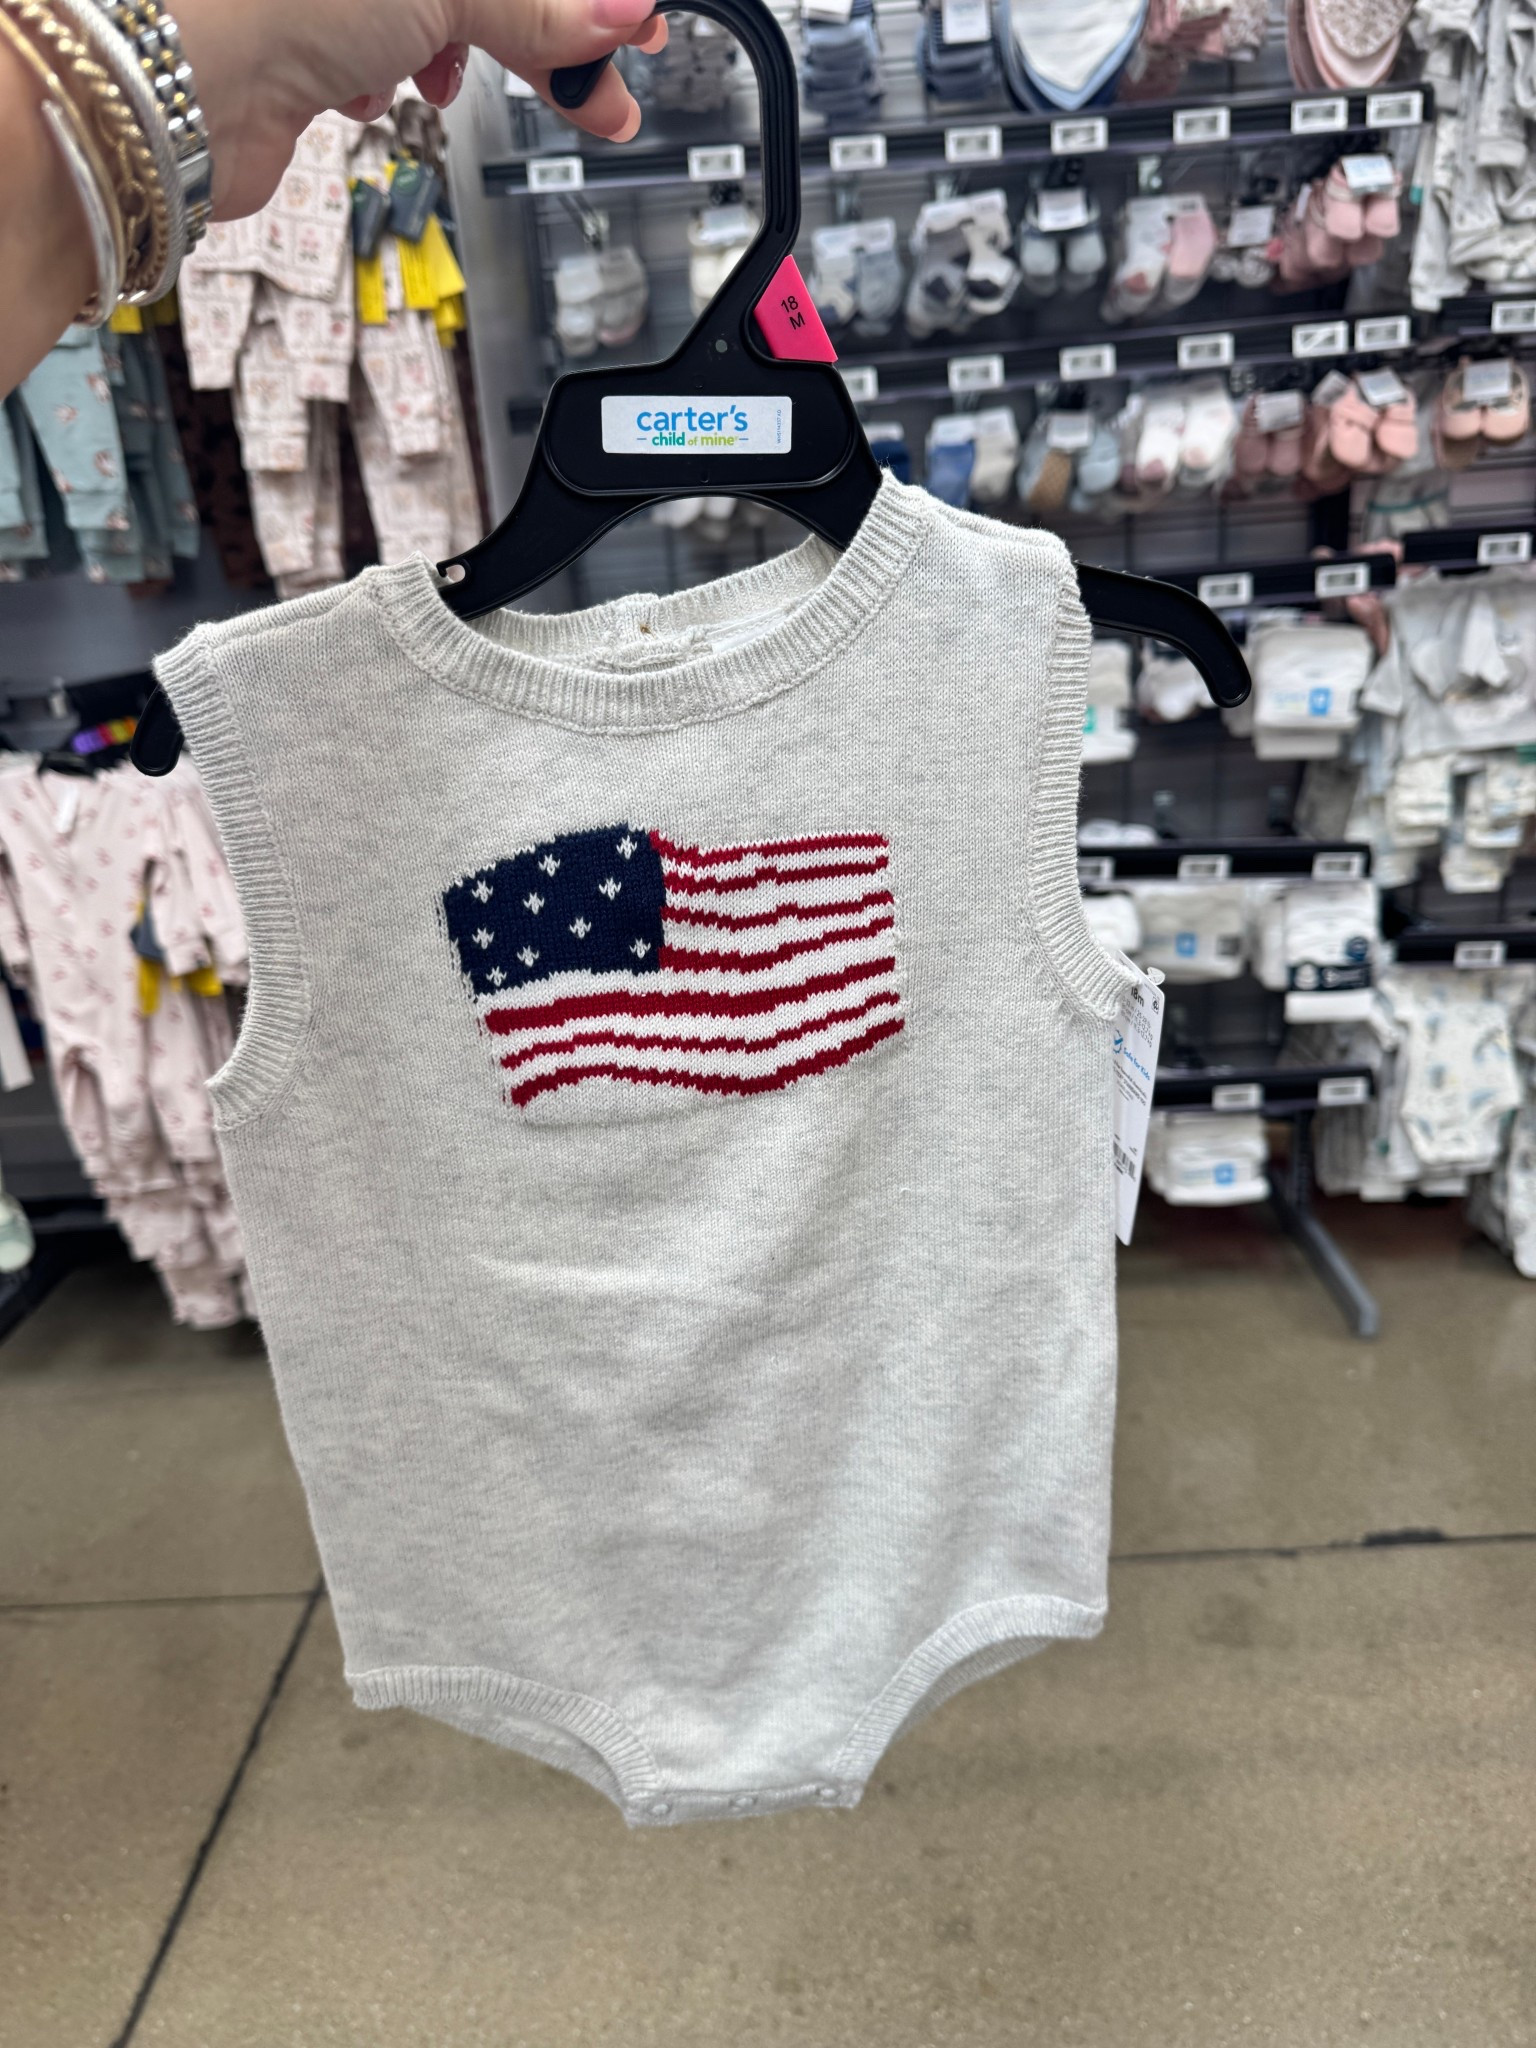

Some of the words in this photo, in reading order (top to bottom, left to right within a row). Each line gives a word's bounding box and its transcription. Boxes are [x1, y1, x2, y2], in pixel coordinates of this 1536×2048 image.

[780, 295, 799, 313] 18
[789, 311, 806, 330] M
[636, 404, 748, 432] carter's
[652, 431, 686, 446] child
[687, 435, 698, 446] of
[700, 432, 736, 446] mine
[1130, 986, 1145, 1007] 18m
